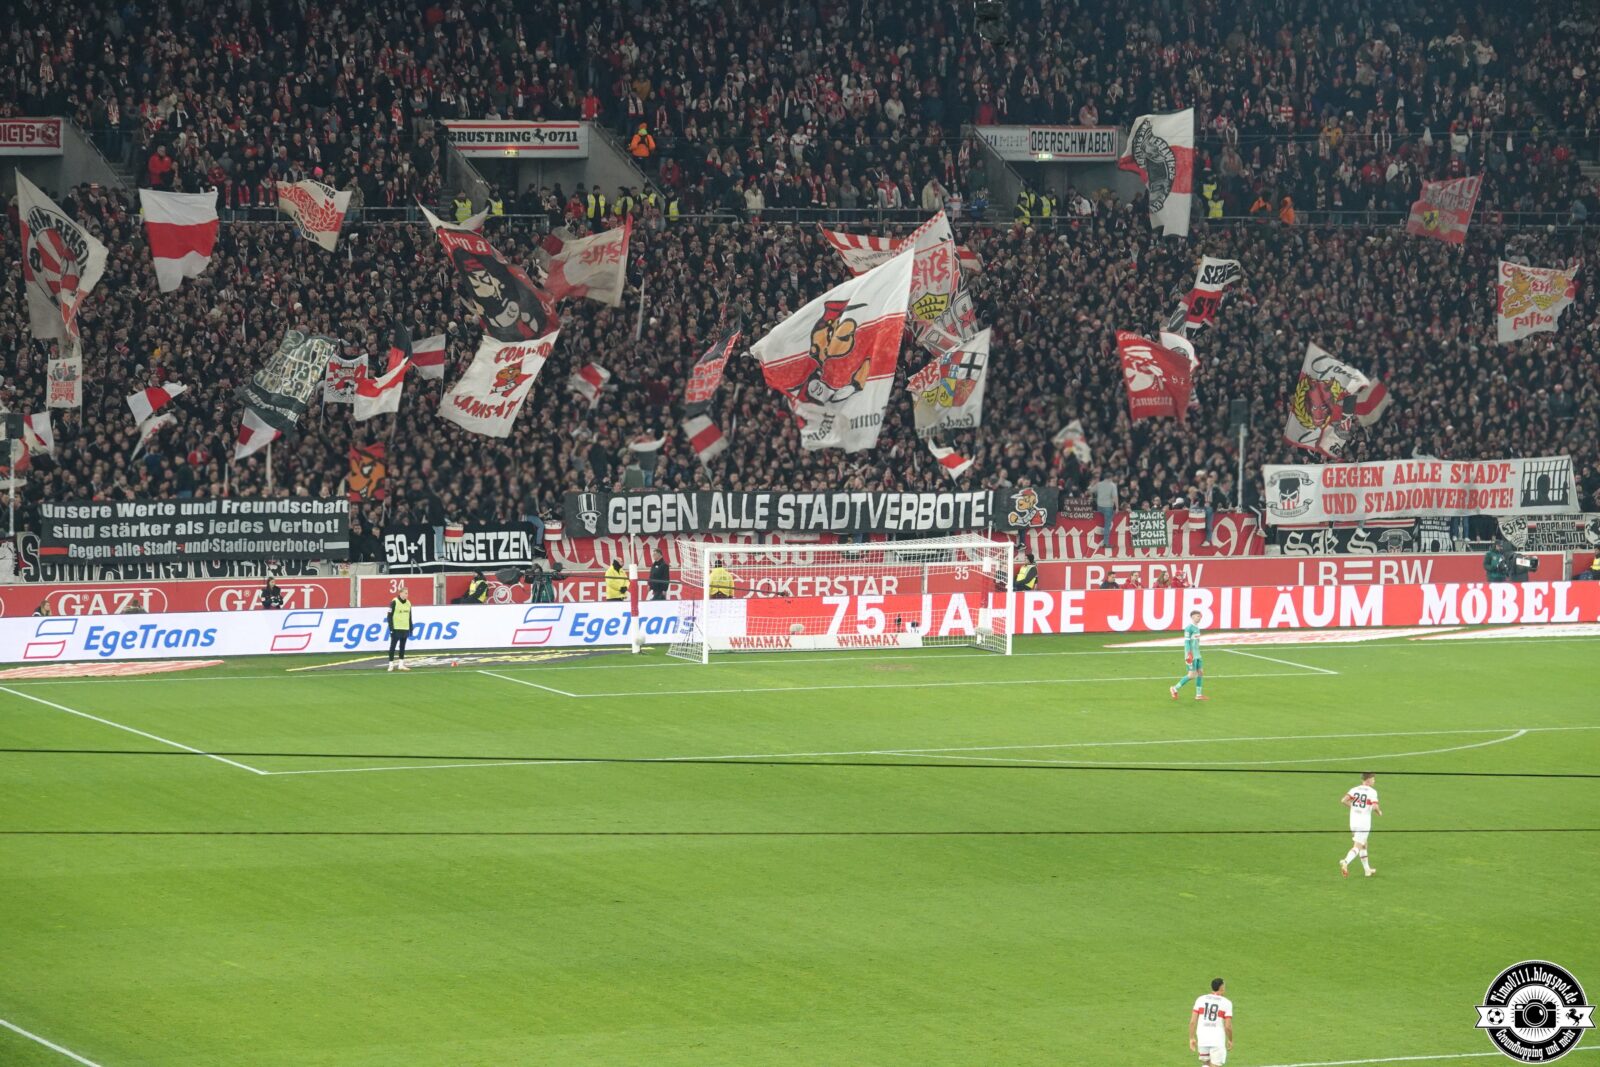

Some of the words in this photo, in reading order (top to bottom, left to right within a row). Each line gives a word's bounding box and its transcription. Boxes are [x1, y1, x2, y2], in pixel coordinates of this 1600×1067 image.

[0, 124, 35, 142] ICTS
[548, 131, 577, 143] 0711
[1031, 131, 1114, 153] OBERSCHWABEN
[1321, 466, 1383, 488] GEGEN
[1392, 463, 1442, 485] ALLE
[1450, 460, 1516, 484] STADT-
[42, 502, 112, 519] Unsere
[116, 501, 176, 518] Werte
[181, 500, 217, 516] und
[221, 498, 349, 515] Freundschaft
[1322, 492, 1357, 515] UND
[1364, 488, 1514, 513] STADIONVERBOTE!
[608, 492, 699, 534] GEGEN
[708, 491, 770, 531] ALLE
[777, 490, 993, 532] STADTVERBOTE!
[1139, 511, 1165, 520] MAGIC
[52, 523, 95, 539] sind
[99, 520, 171, 538] stärker
[175, 519, 204, 535] als
[208, 519, 264, 536] jedes
[269, 518, 340, 535] Verbot!
[1140, 519, 1166, 530] FANS
[1140, 530, 1166, 539] POUR
[1212, 515, 1257, 558] 97
[68, 543, 112, 559] Gegen
[114, 542, 141, 557] alle
[143, 540, 182, 556] Stadt-
[184, 540, 209, 555] und
[212, 538, 325, 554] Stadionverbote!
[384, 533, 427, 563] 50+1
[954, 566, 969, 580] 35
[389, 578, 405, 594] 34
[822, 596, 886, 635] 75
[905, 590, 1086, 637] JAHRE
[1106, 586, 1384, 631] JUBILÄUM
[1418, 581, 1580, 626] MÖBEL
[83, 624, 218, 657] EgeTrans
[729, 635, 792, 648] WINAMAX
[837, 634, 900, 647] WINAMAX
[1352, 792, 1368, 808] 29
[1203, 1002, 1219, 1022] 18
